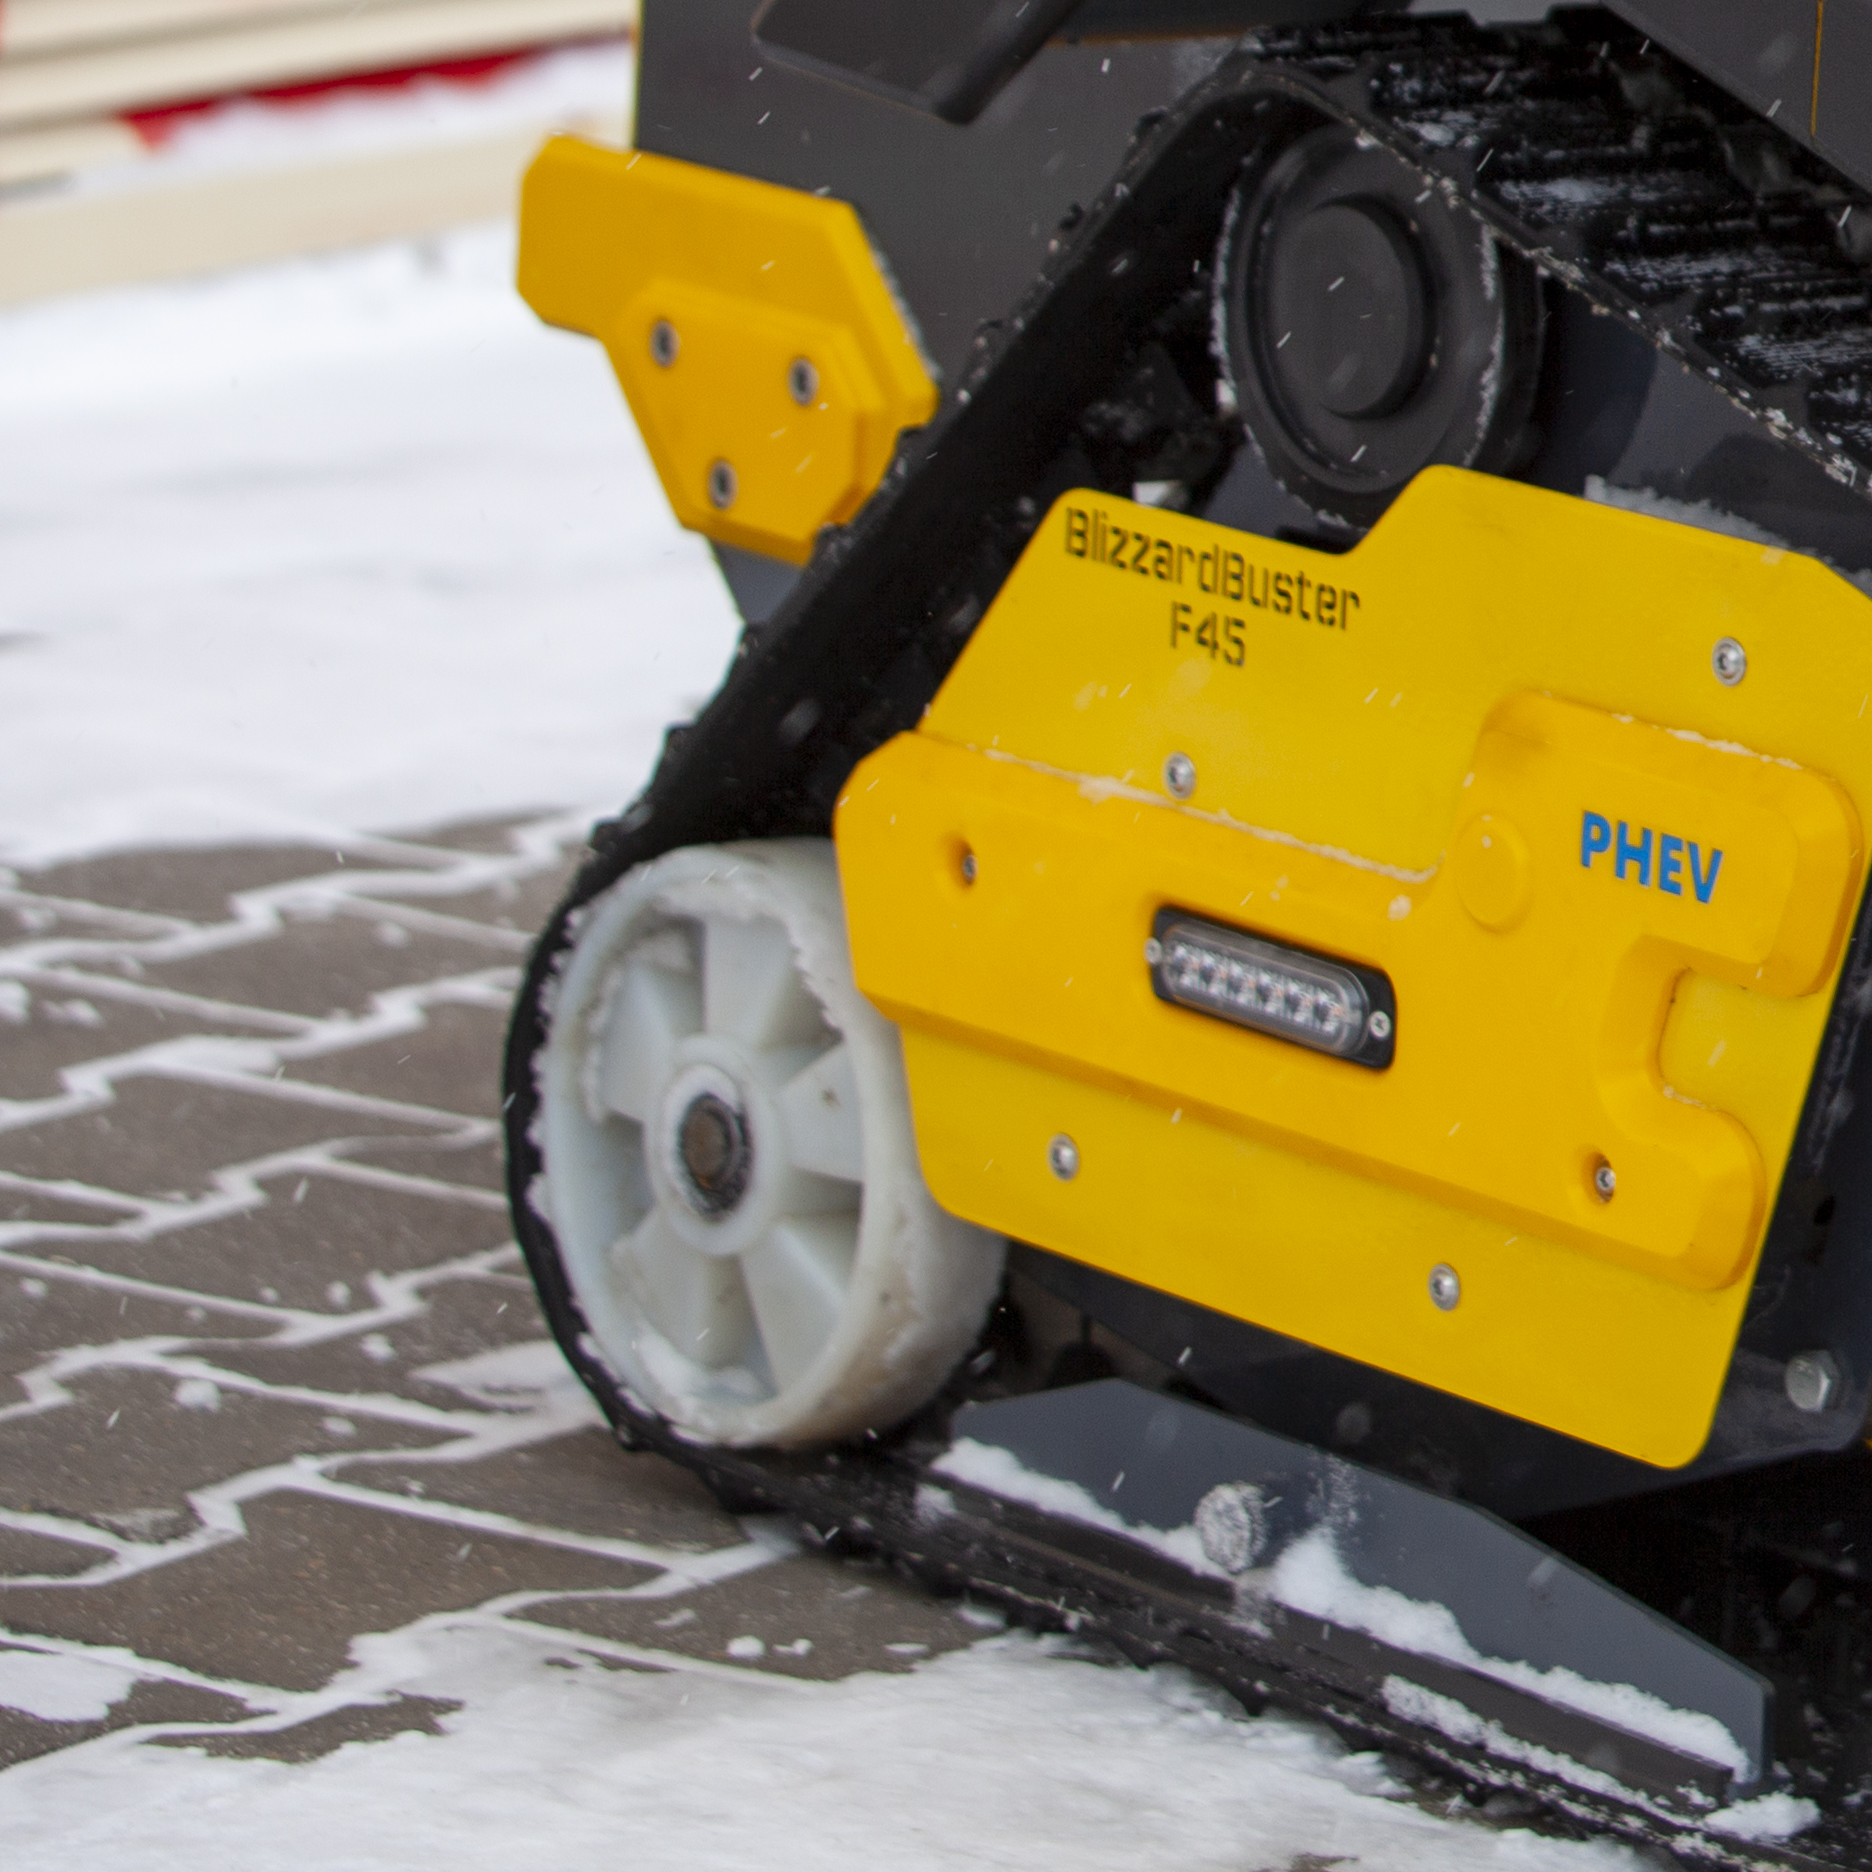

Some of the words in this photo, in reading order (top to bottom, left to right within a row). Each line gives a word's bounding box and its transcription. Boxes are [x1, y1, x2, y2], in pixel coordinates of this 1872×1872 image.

[1064, 506, 1361, 631] BlizzardBuster
[1170, 601, 1247, 668] F45
[1580, 810, 1724, 905] PHEV
